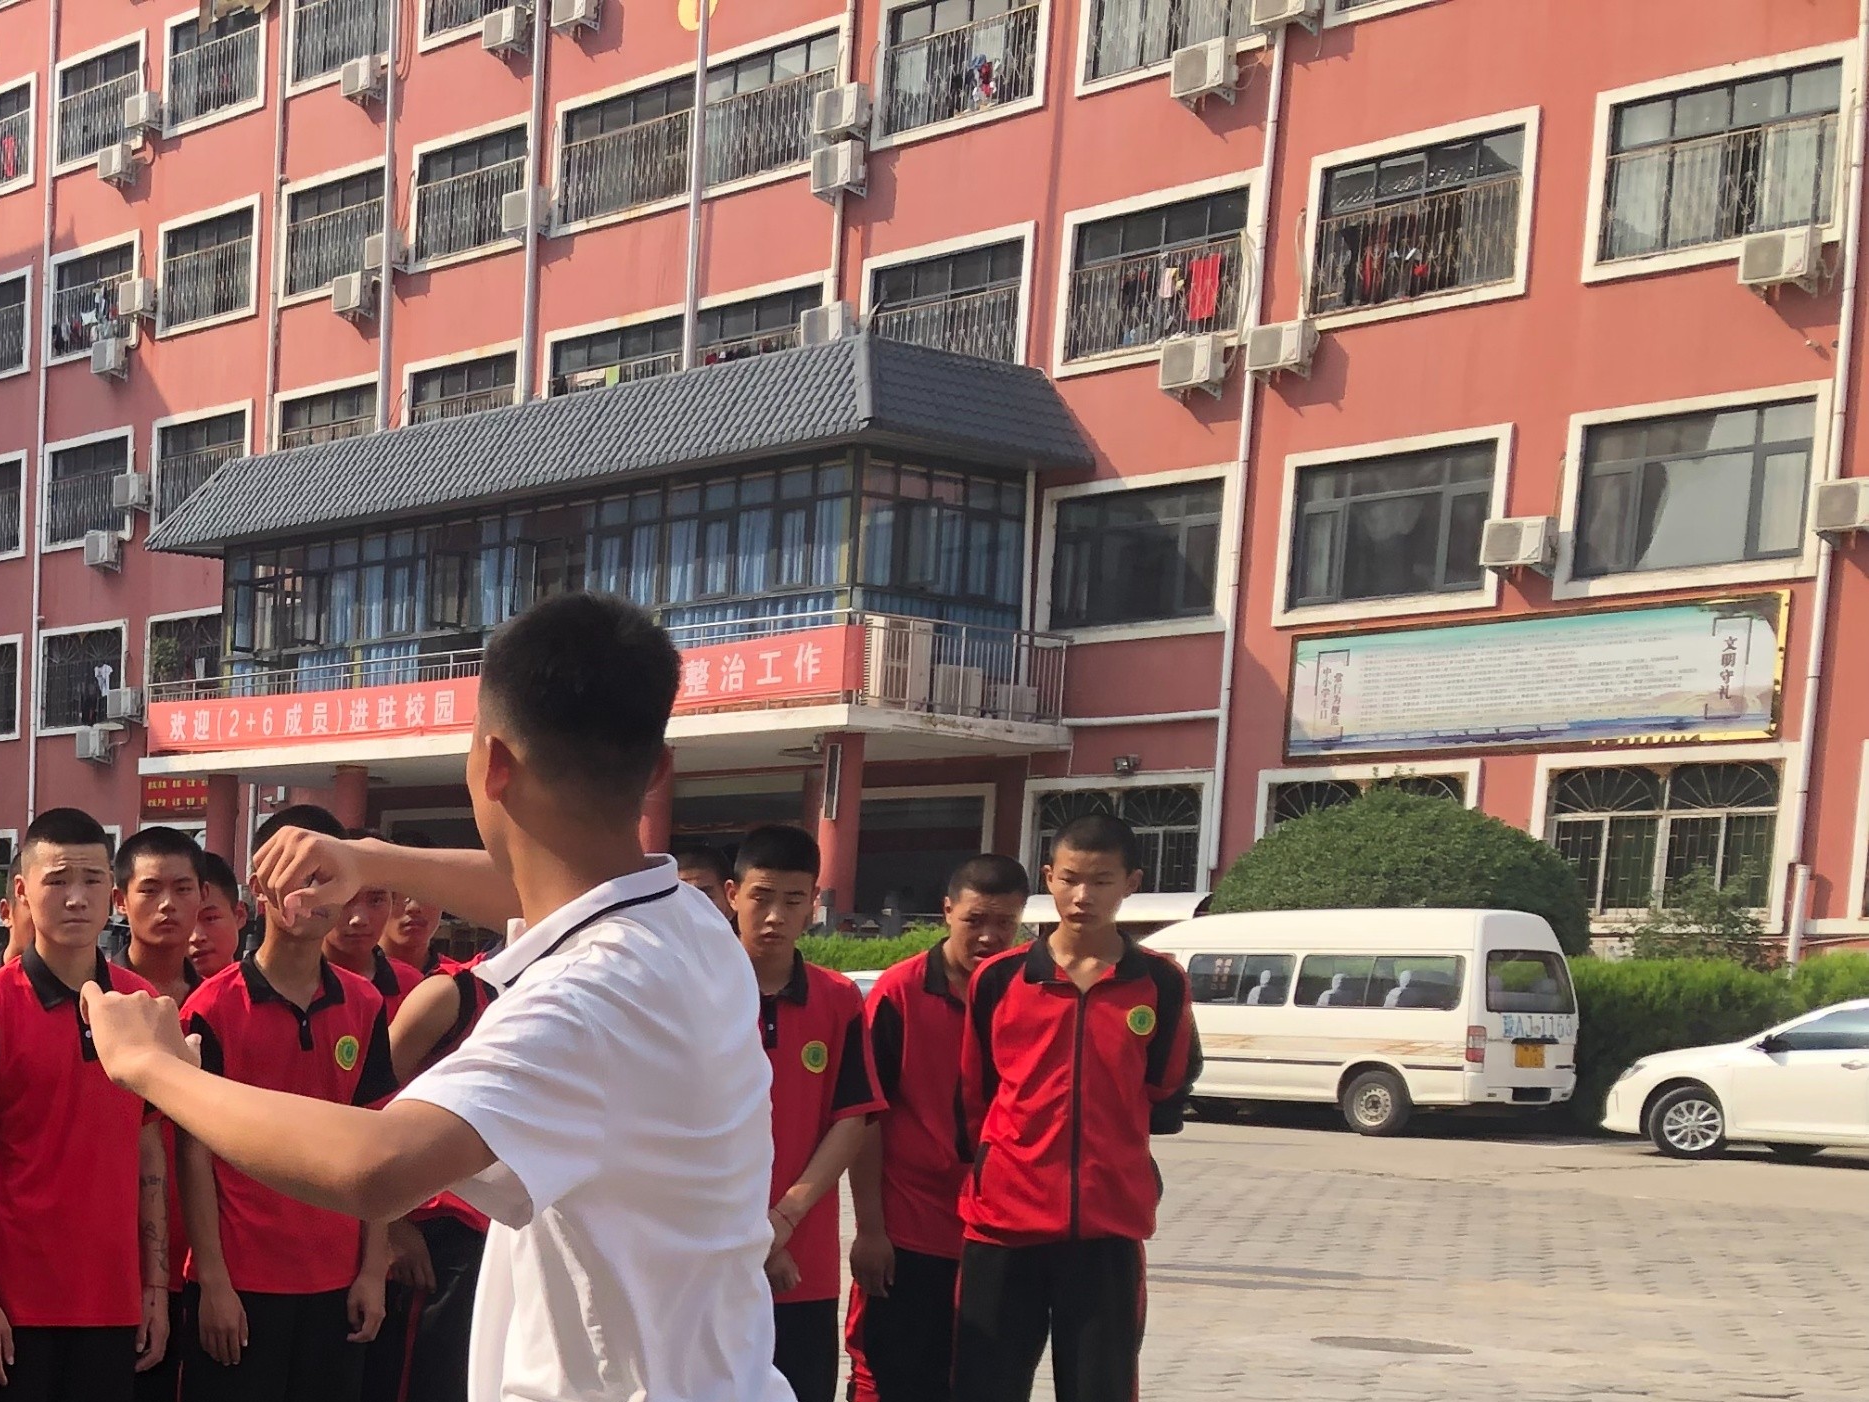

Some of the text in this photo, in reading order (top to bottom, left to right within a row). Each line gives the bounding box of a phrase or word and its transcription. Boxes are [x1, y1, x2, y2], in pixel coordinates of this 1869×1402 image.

[683, 641, 822, 697] 整治工作
[1718, 636, 1738, 700] 文明守礼
